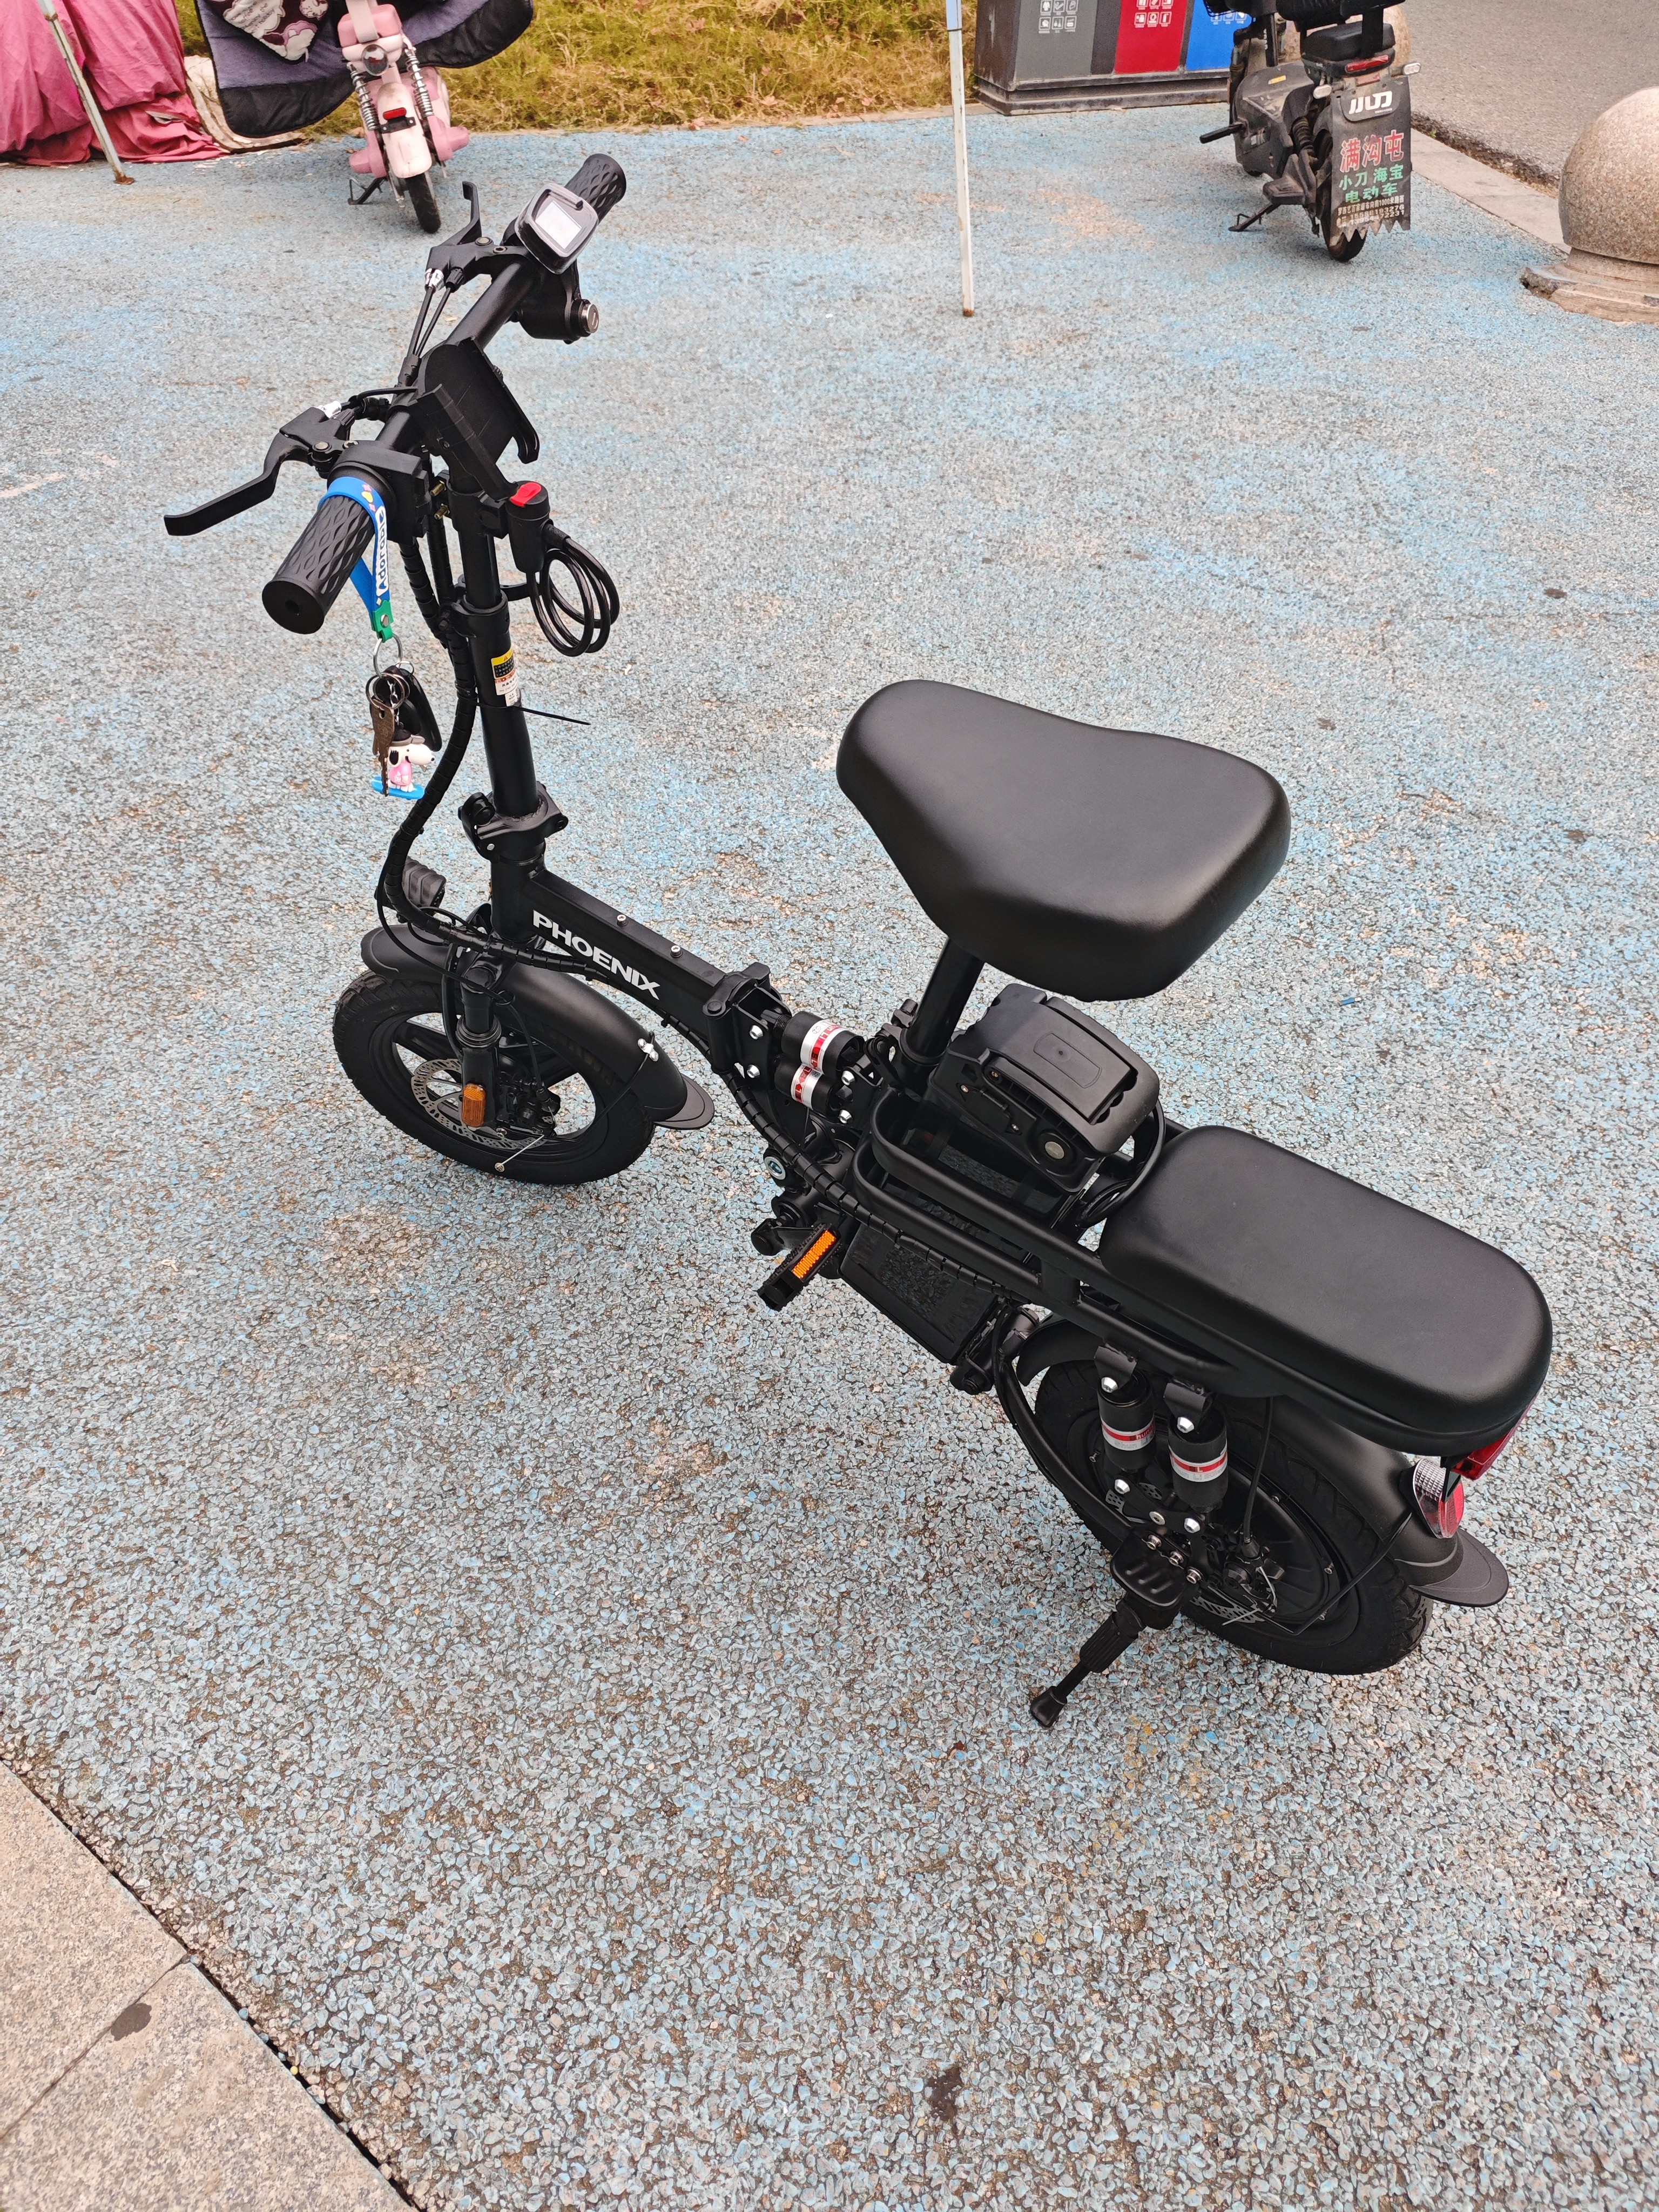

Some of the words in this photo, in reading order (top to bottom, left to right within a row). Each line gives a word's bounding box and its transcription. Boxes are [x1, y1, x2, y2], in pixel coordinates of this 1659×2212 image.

[1348, 91, 1393, 114] 小刀
[1340, 130, 1404, 173] 满沟屯
[1339, 171, 1368, 191] 小刀
[1373, 164, 1404, 184] 海宝
[1345, 183, 1398, 203] 电动车
[377, 509, 387, 590] Adorable
[532, 909, 660, 1001] PHOENIX
